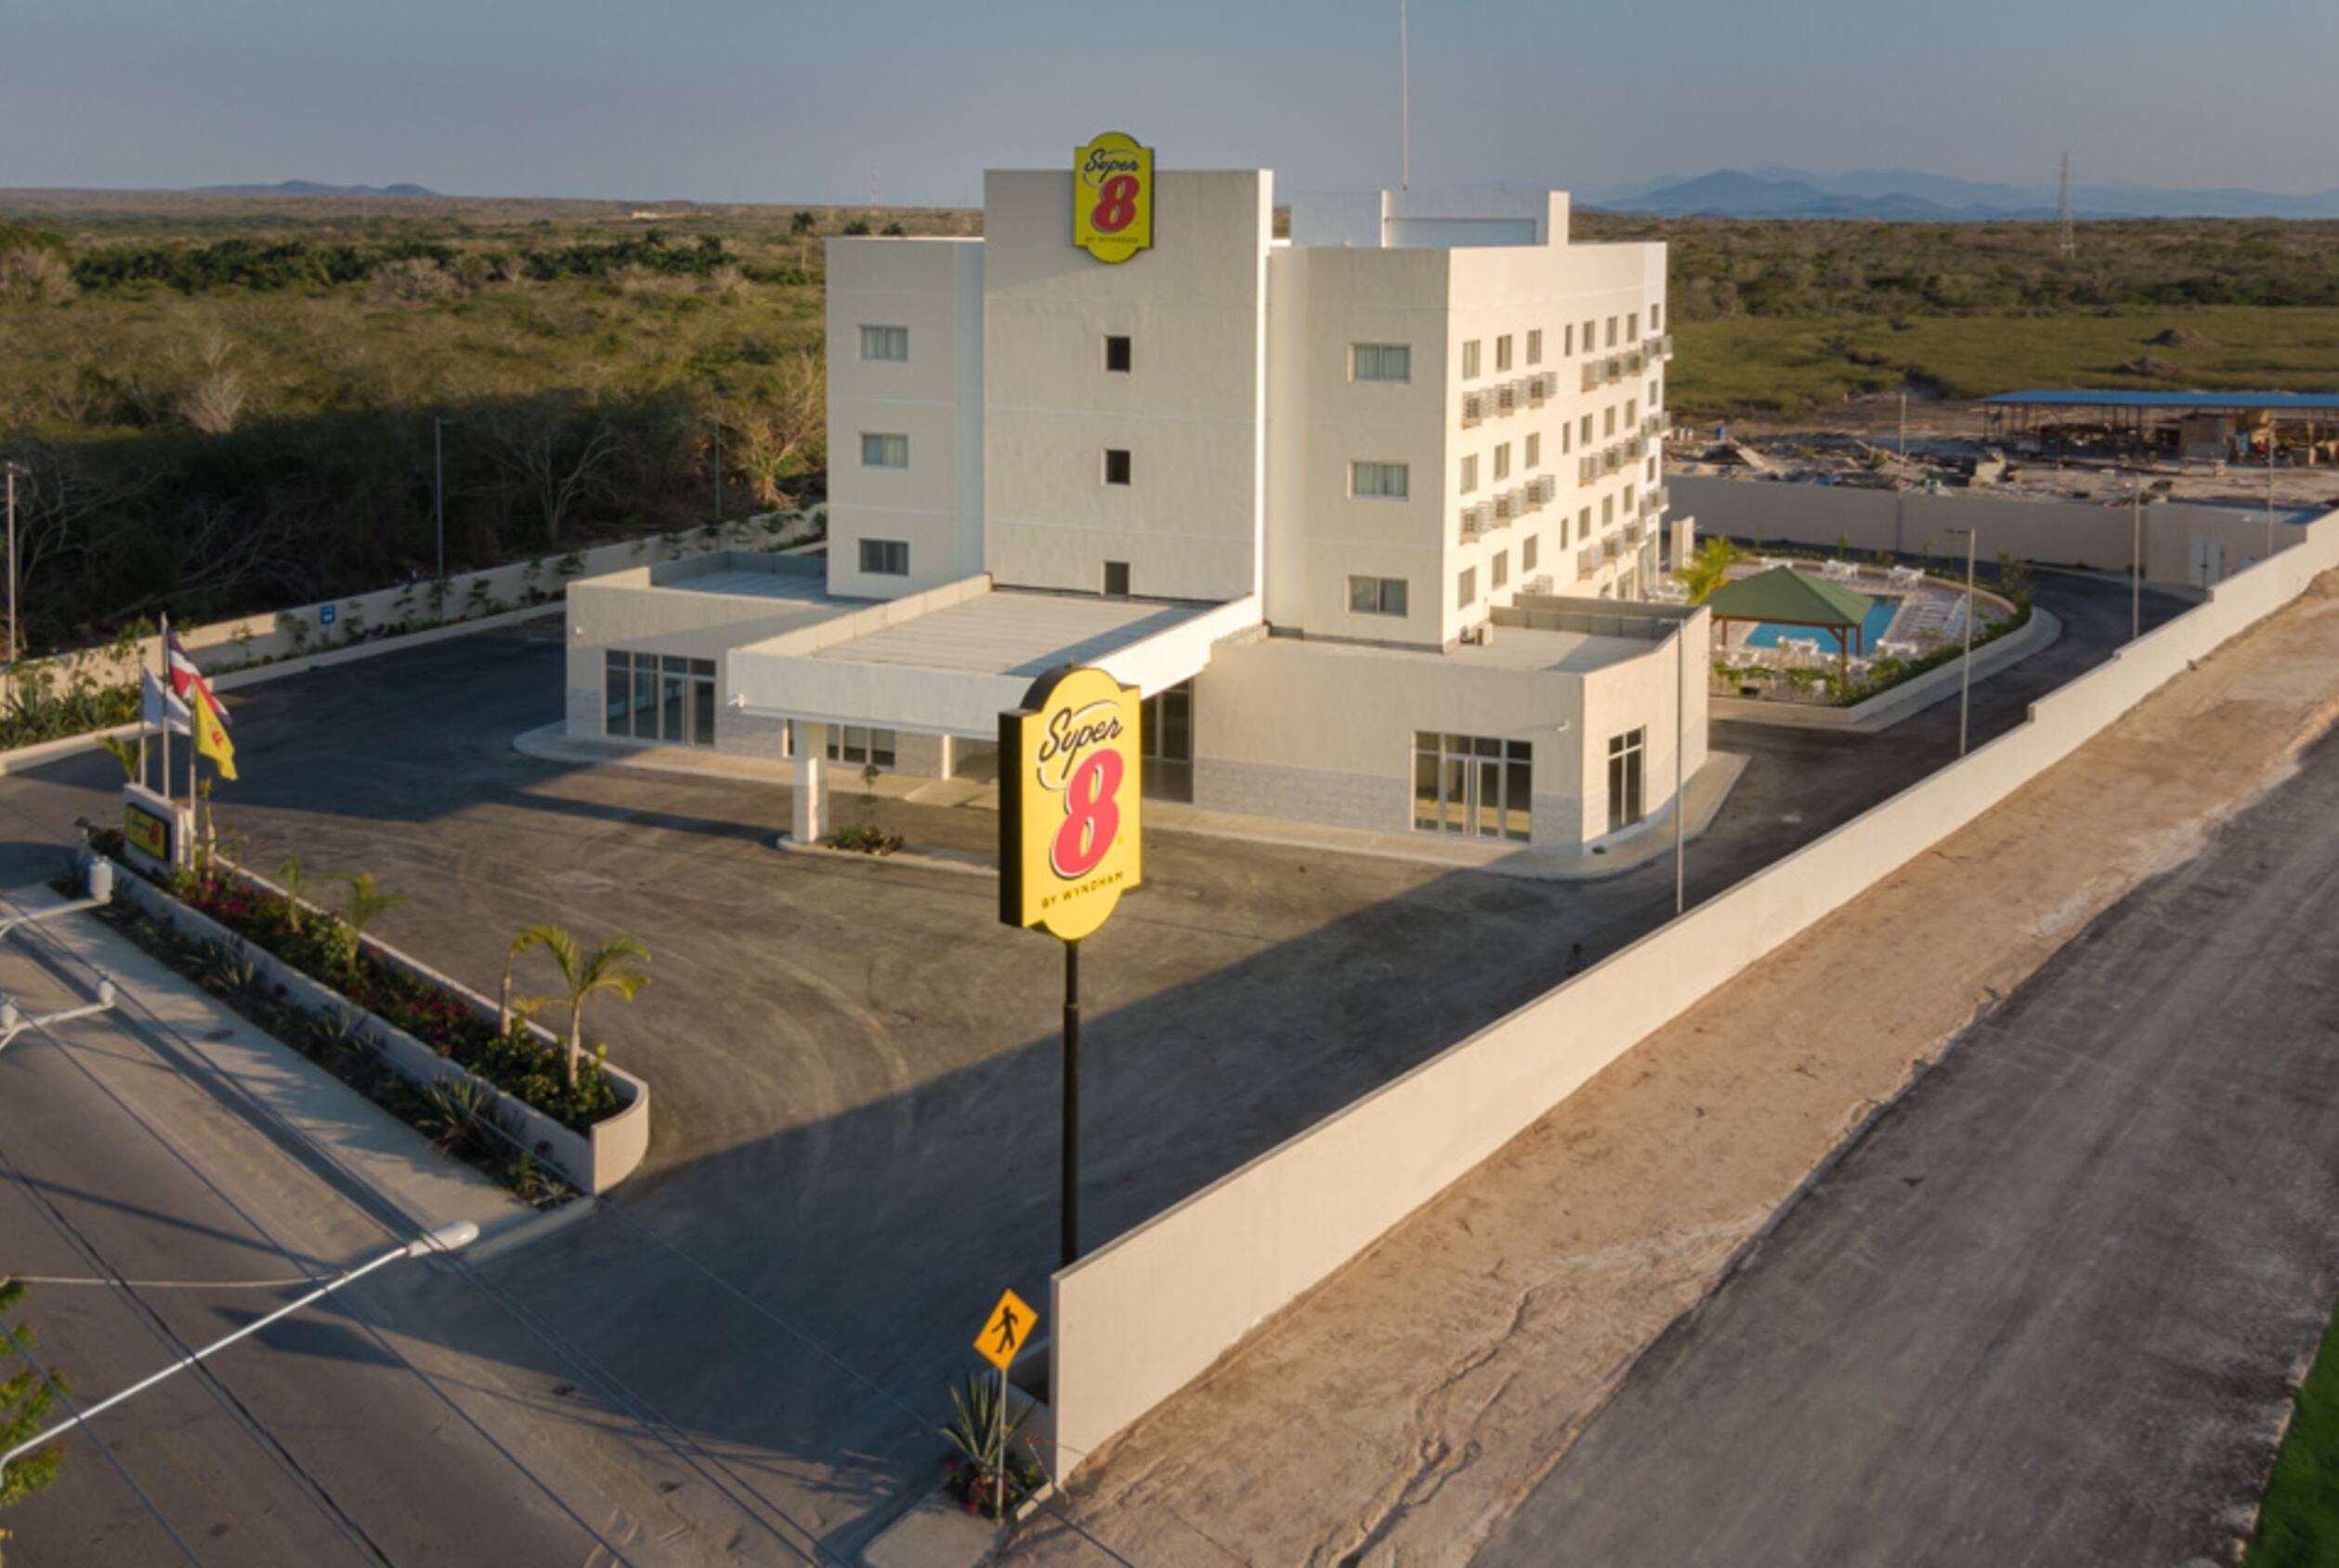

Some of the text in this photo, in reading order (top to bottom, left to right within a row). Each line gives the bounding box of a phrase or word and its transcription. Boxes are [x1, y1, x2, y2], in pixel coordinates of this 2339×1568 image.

[1083, 149, 1139, 184] Super
[1091, 174, 1141, 233] 8
[1039, 706, 1123, 780] Super
[1049, 748, 1124, 881] 8
[1041, 870, 1124, 909] BY WYNDHAM
